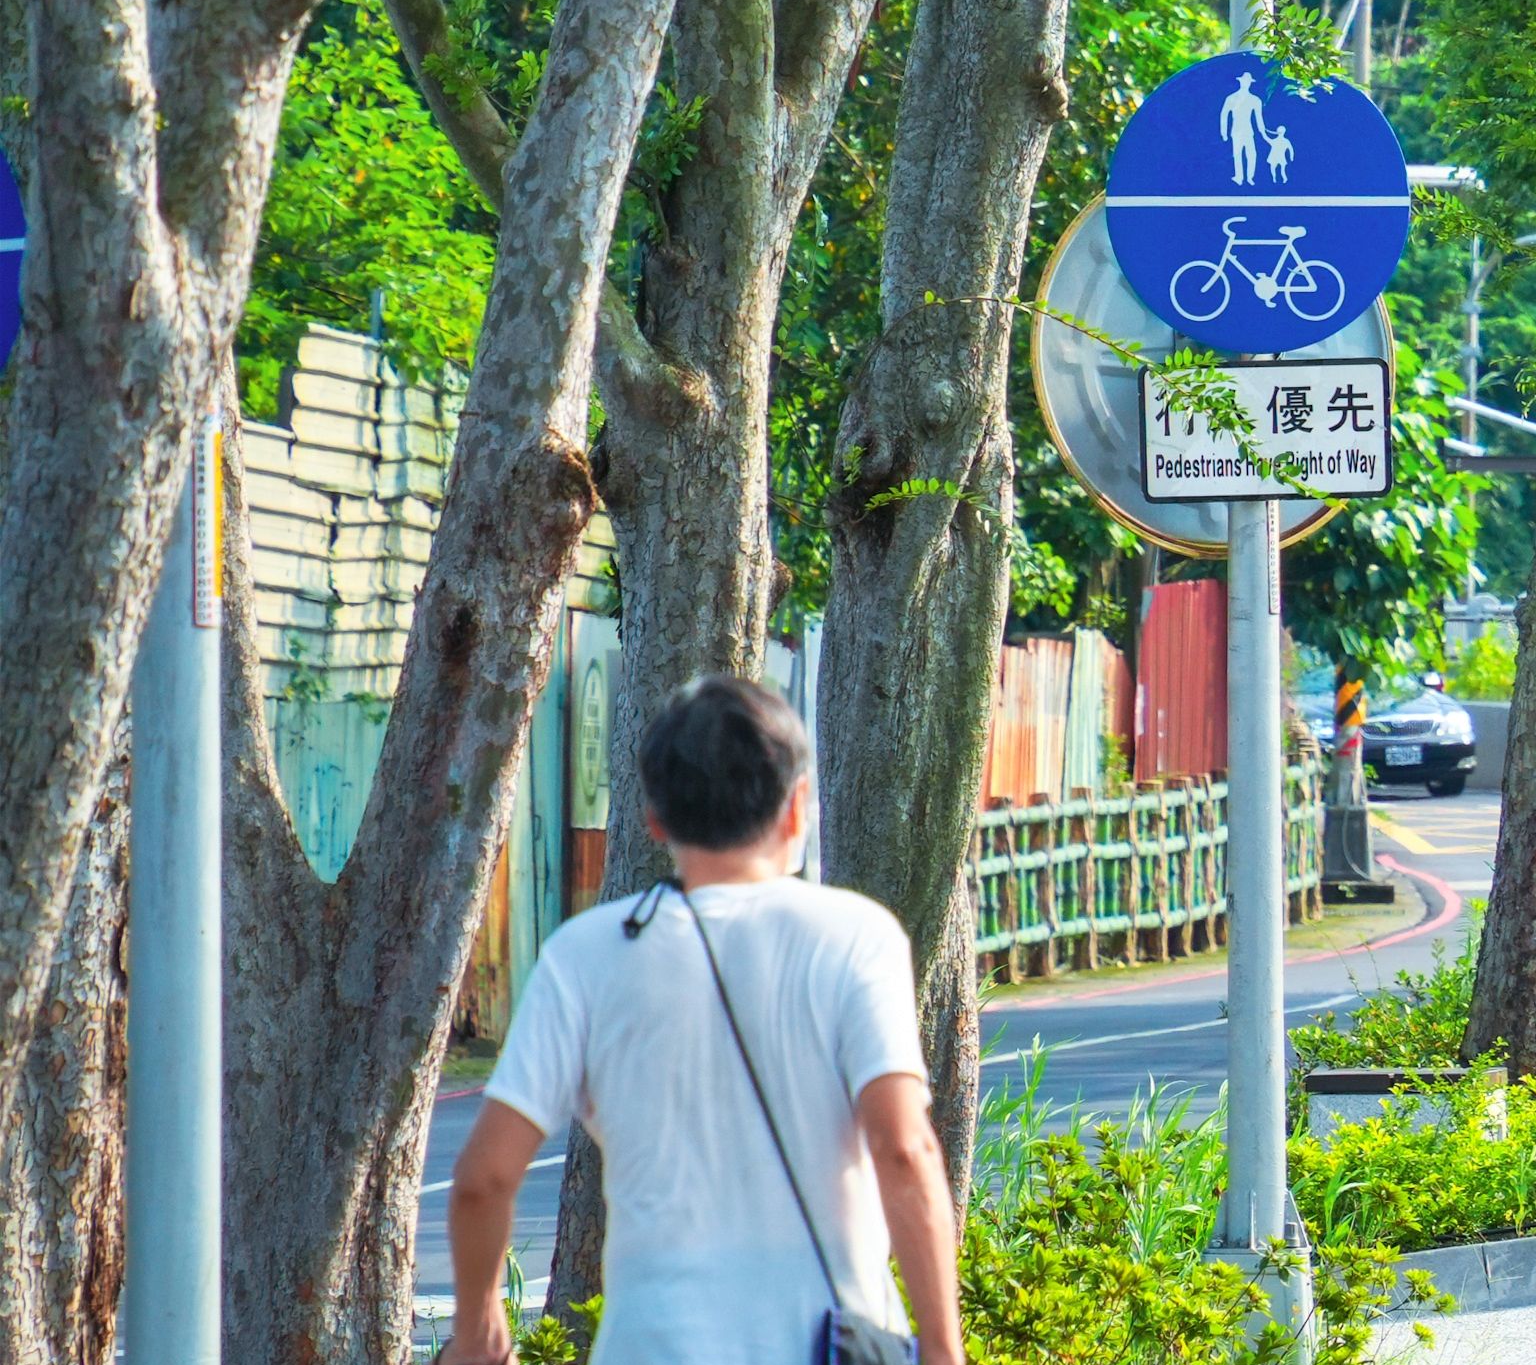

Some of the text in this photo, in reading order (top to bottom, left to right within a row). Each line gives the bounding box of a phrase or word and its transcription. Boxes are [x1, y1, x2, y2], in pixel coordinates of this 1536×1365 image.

[1155, 453, 1242, 479] Pedestrians
[1327, 449, 1341, 475] of
[1345, 448, 1376, 480] Way
